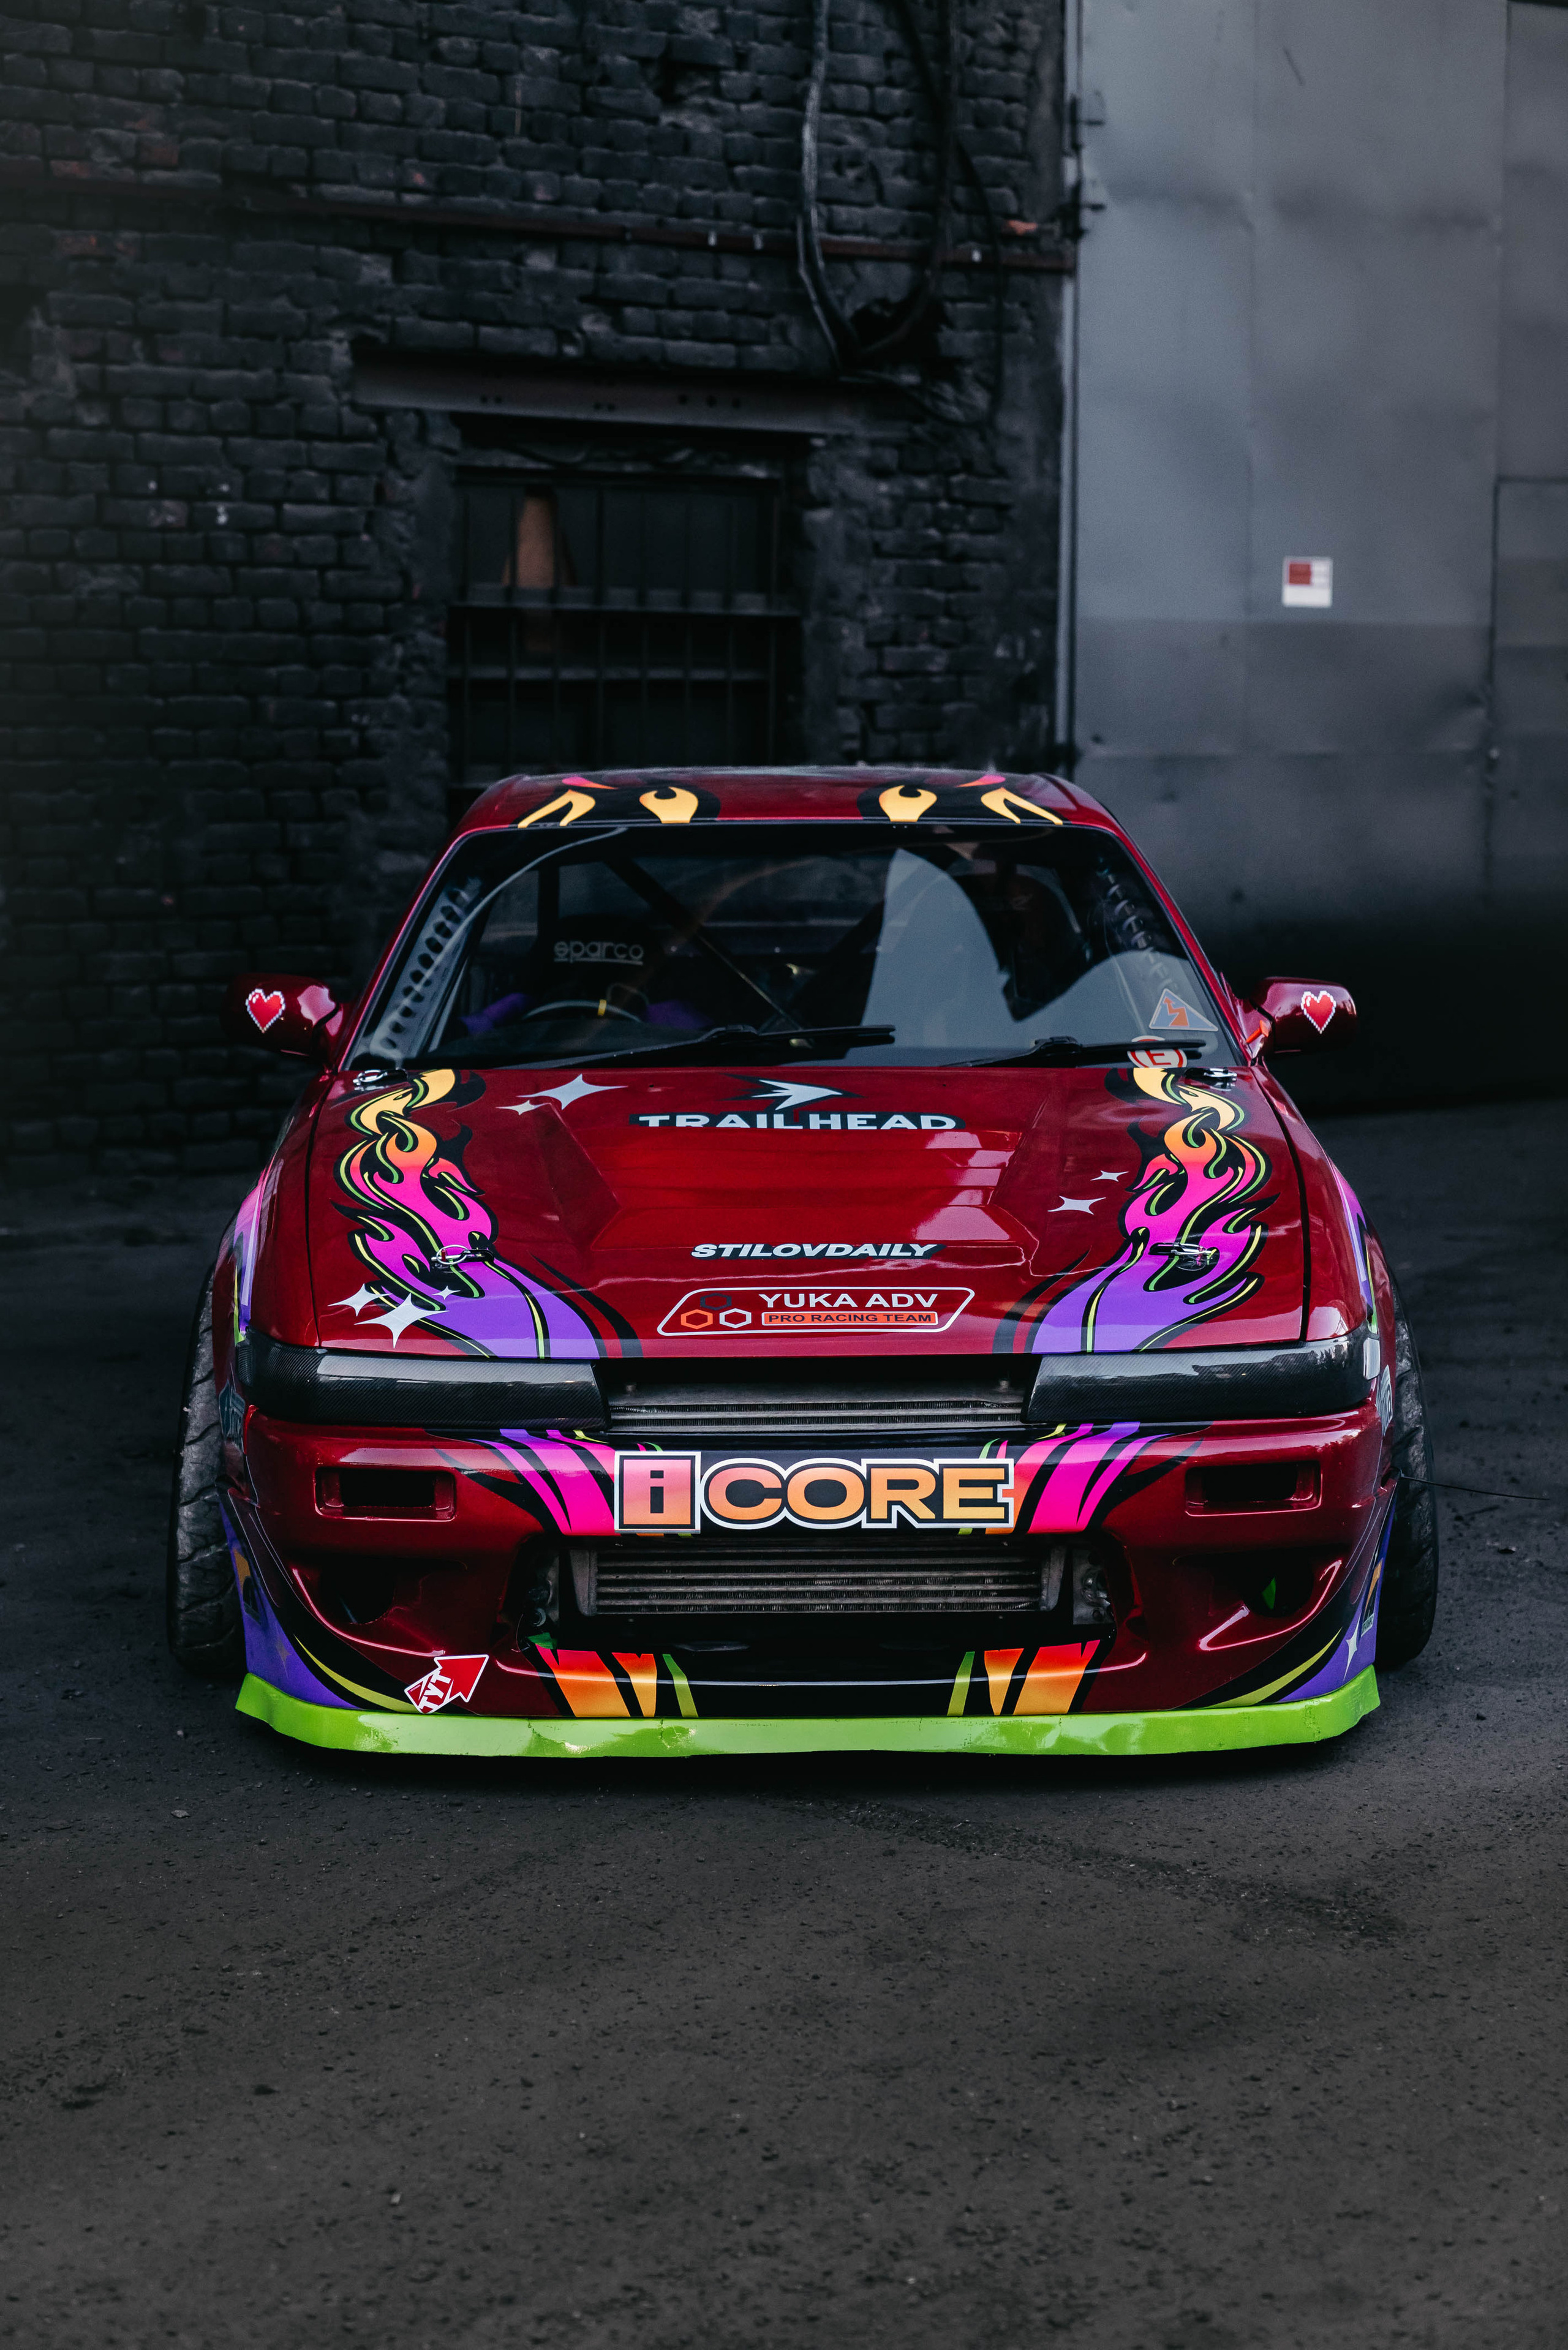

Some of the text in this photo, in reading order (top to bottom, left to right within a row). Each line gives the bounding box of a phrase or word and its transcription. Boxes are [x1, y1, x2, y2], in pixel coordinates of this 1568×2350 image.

[553, 940, 644, 964] sparco
[638, 1113, 957, 1130] TRAILHEAD
[691, 1243, 938, 1257] STILOVDAILY
[758, 1293, 938, 1308] YUKA ADV
[811, 1314, 878, 1322] RACING
[883, 1314, 932, 1322] TEAM
